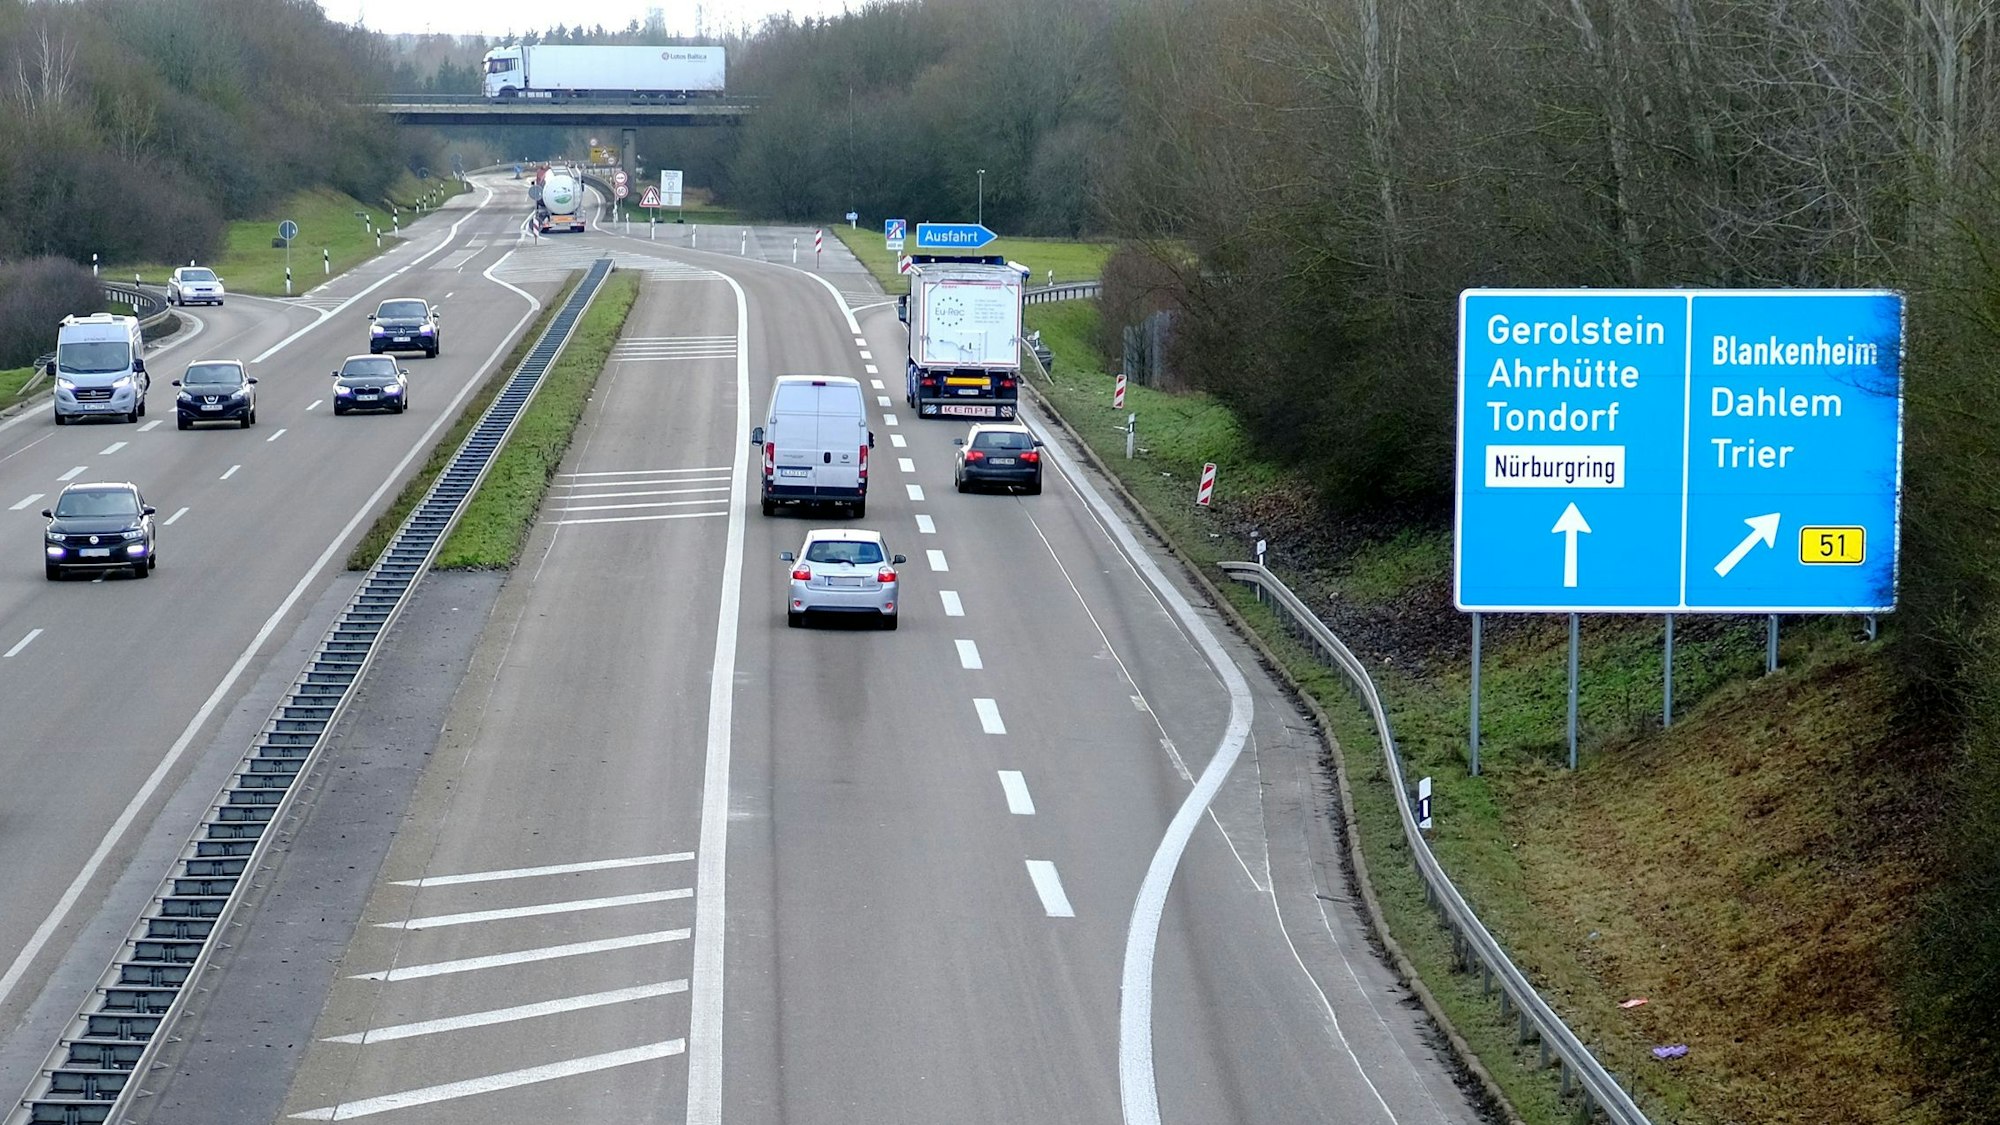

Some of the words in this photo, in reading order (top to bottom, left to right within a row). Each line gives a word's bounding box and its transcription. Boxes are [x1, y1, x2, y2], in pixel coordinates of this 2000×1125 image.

[924, 229, 978, 242] Ausfahrt
[1487, 314, 1665, 345] Gerolstein
[1712, 334, 1878, 366] Blankenheim
[1487, 357, 1640, 388] Ahrhütte
[943, 405, 994, 415] KEMPF
[1487, 401, 1620, 432] Tondorf
[1711, 386, 1843, 417] Dahlem
[1711, 437, 1795, 468] Trier
[1494, 454, 1615, 484] Nürburgring
[1819, 534, 1847, 557] 51
